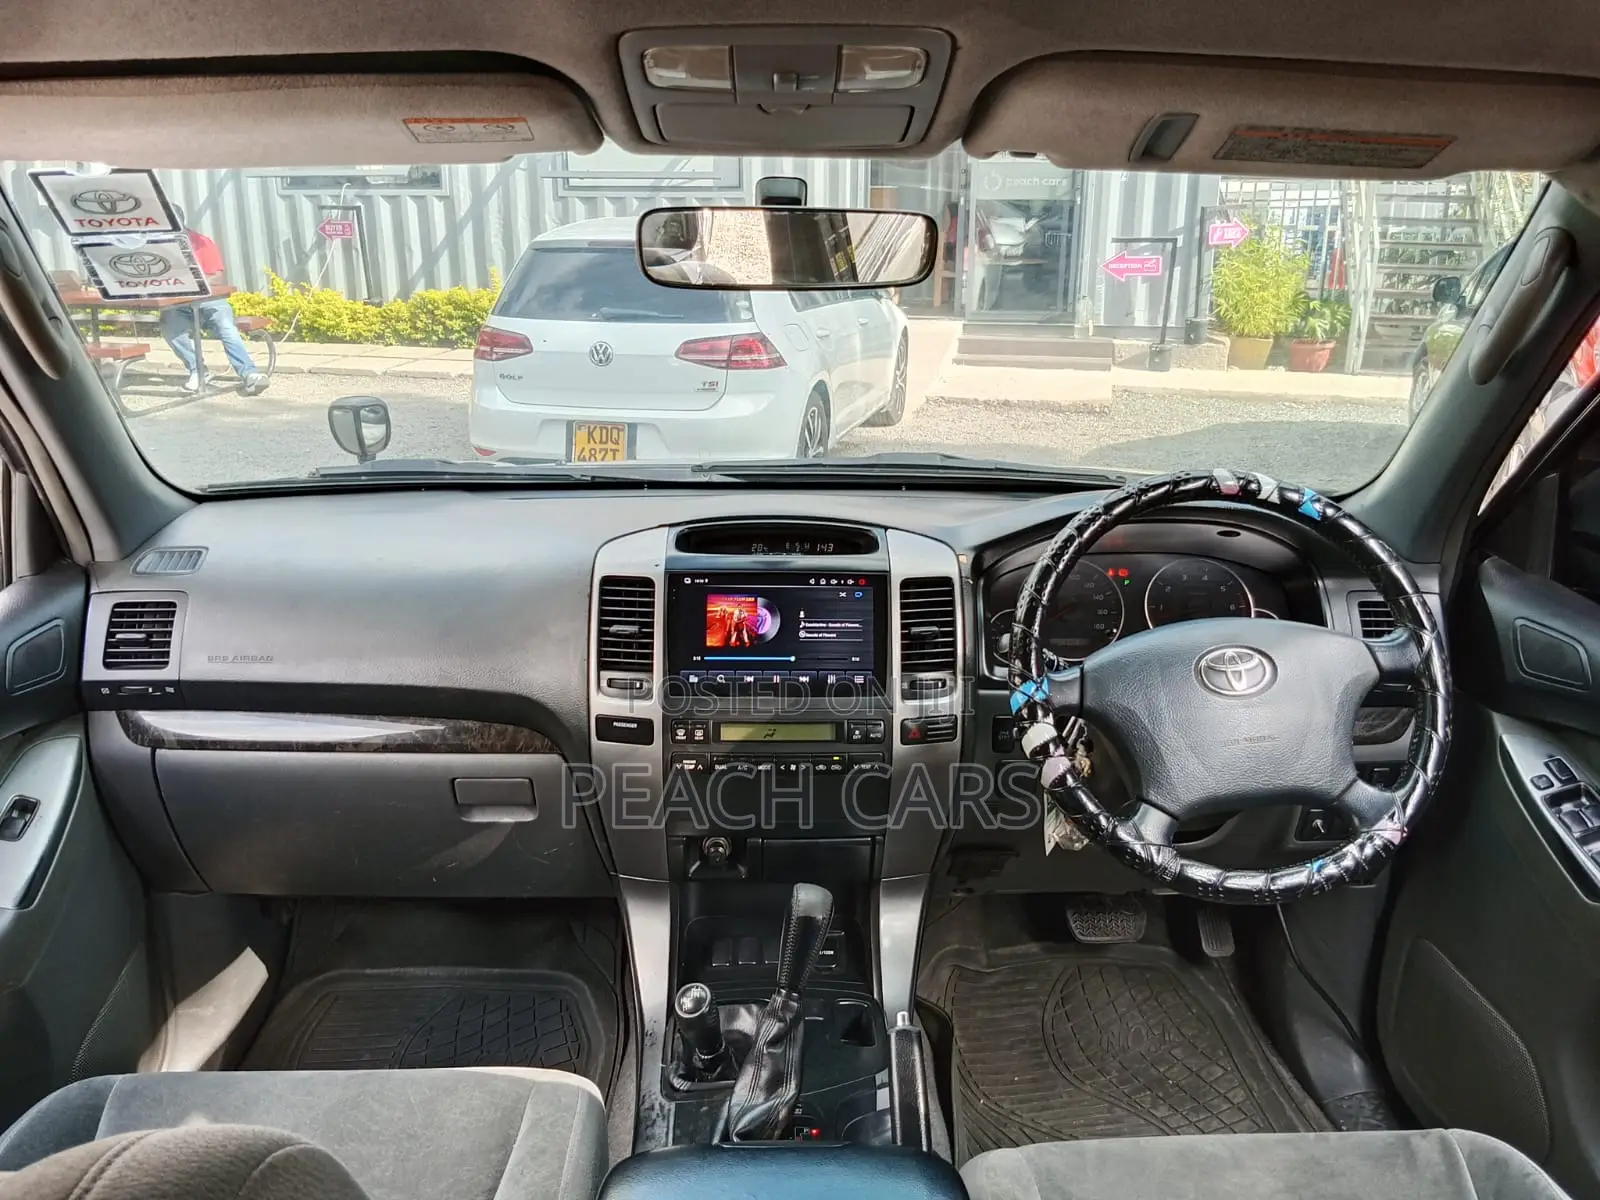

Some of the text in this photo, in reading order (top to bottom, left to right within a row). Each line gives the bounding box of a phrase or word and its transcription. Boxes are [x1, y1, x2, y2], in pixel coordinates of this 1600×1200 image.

[74, 217, 160, 228] TOYOTA
[115, 278, 186, 289] TOYOTA
[499, 373, 523, 381] GOLF
[587, 425, 620, 445] KDQ
